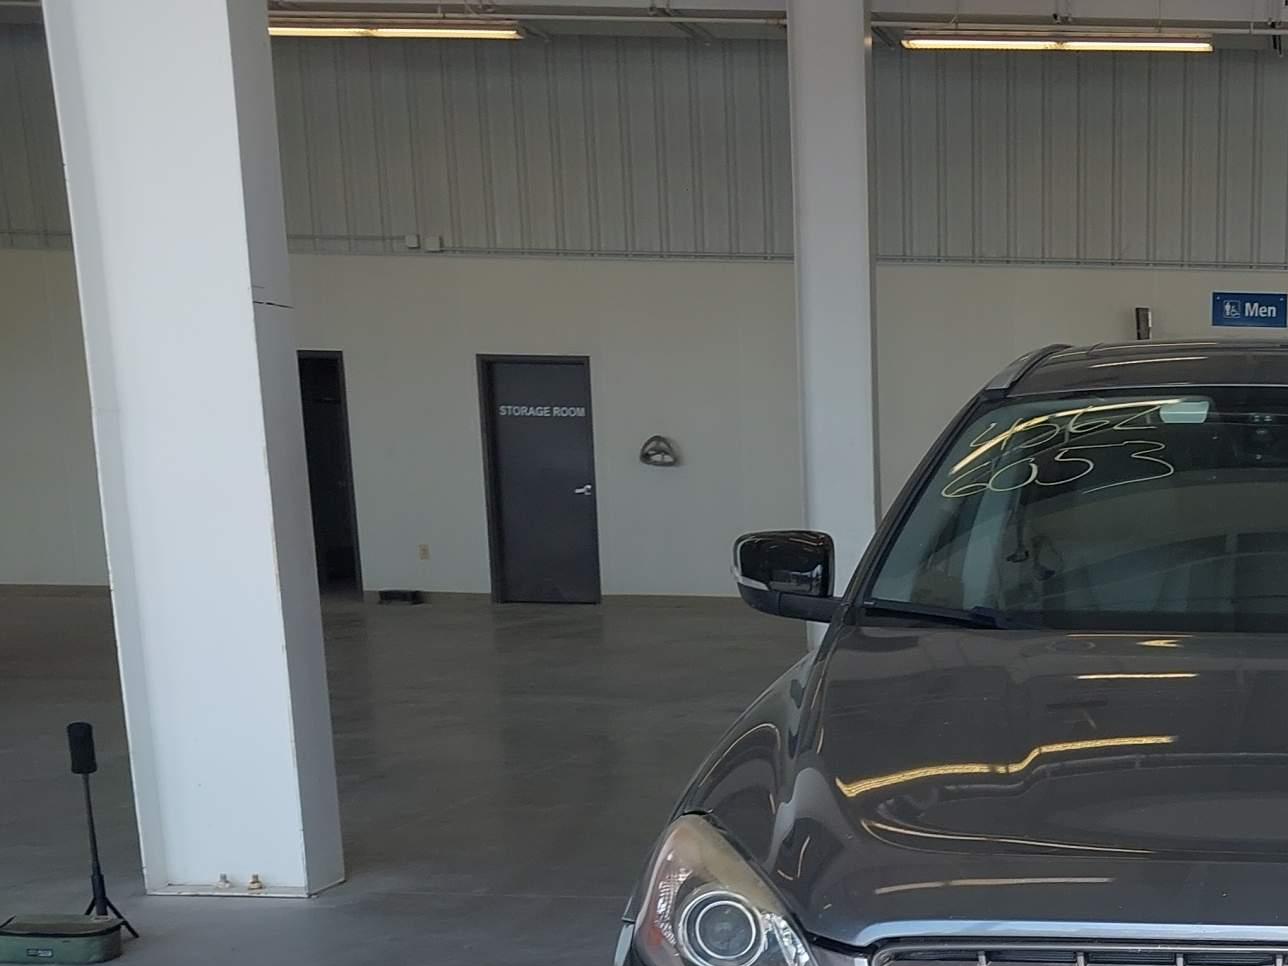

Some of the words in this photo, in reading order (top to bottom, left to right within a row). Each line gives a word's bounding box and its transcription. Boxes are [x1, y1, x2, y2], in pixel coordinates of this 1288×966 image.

[1244, 302, 1277, 317] Men
[499, 405, 551, 417] STORAGE
[553, 406, 586, 417] ROOM
[941, 440, 1175, 498] 6053
